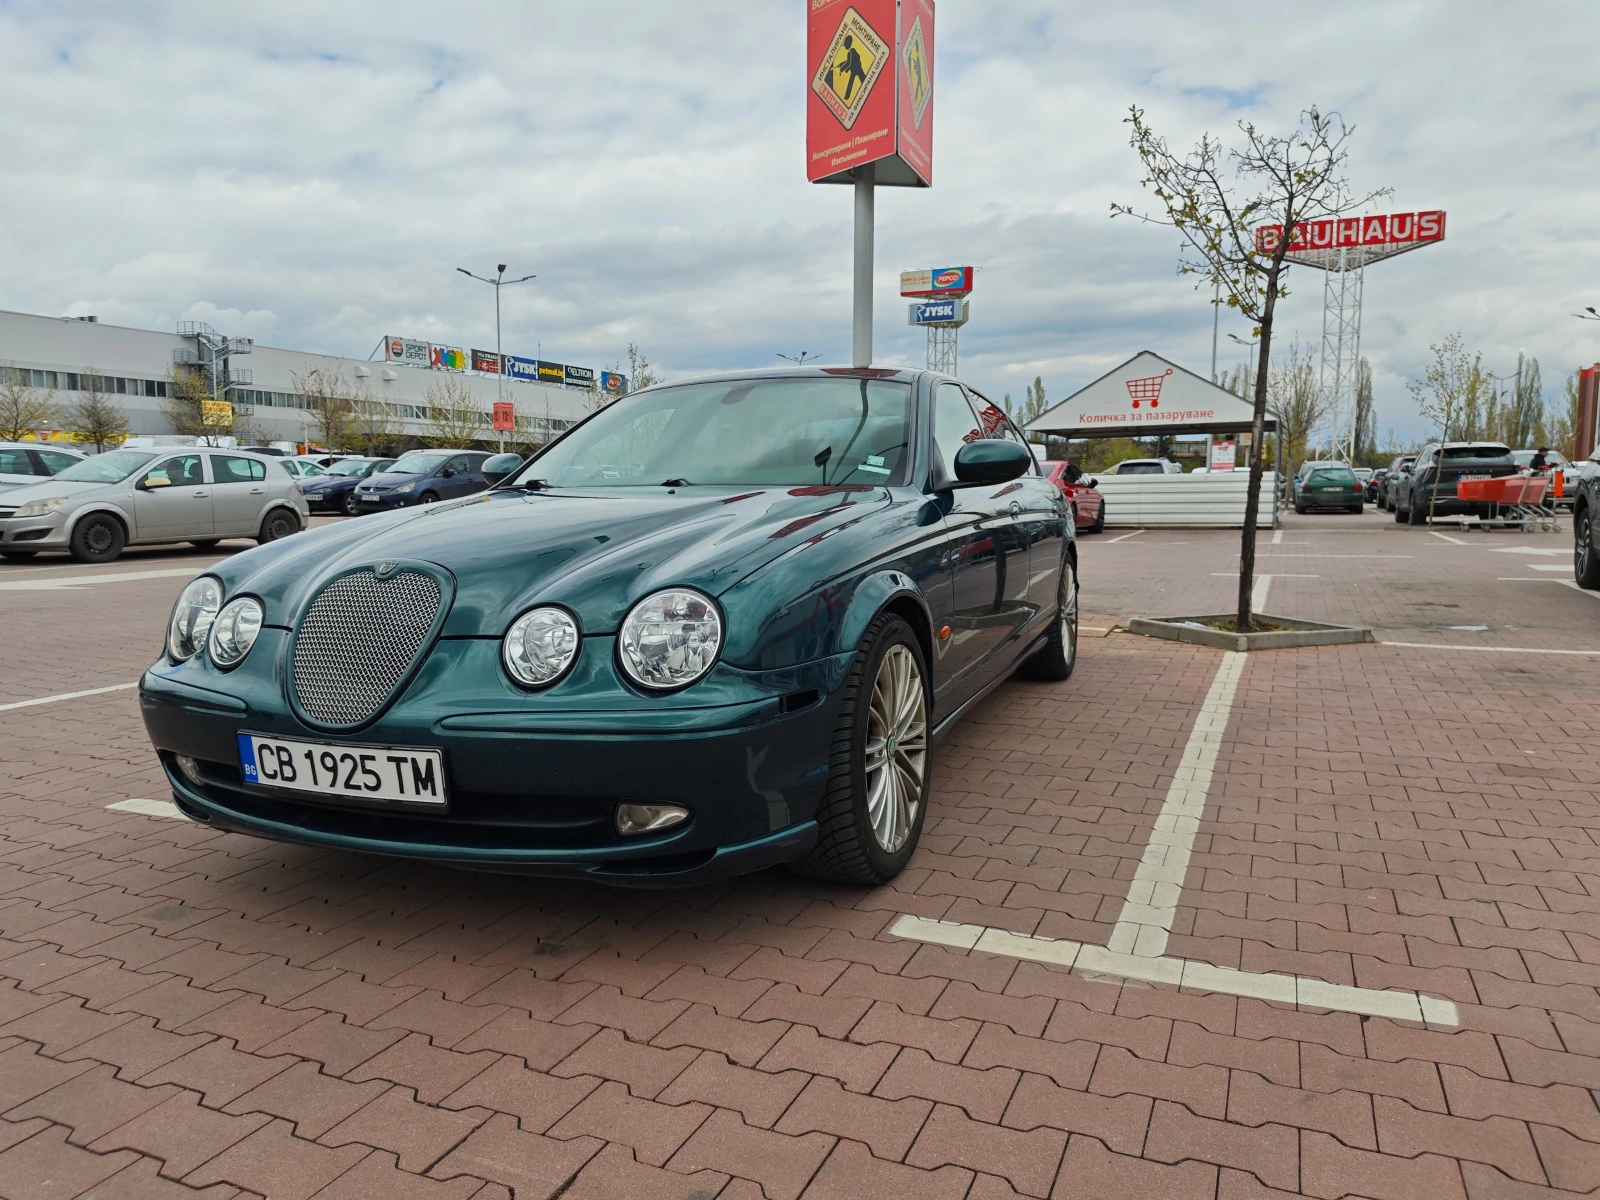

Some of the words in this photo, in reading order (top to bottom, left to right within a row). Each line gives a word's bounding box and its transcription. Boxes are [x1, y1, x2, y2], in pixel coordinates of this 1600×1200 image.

[851, 17, 882, 53] МОНТИРАНЕ
[818, 22, 848, 81] ИНСТАЛИРАНЕ
[853, 70, 876, 111] ФИКСИРАНА
[874, 51, 886, 71] ЦЕНА
[819, 82, 848, 122] BAUHAUS
[854, 128, 888, 146] Планиране
[831, 148, 868, 166] Изпълнение
[938, 273, 957, 282] PEPCO
[924, 305, 953, 317] JYSK
[405, 343, 427, 353] SPORT
[405, 351, 427, 361] DEPOT
[513, 361, 536, 375] JYSK
[1079, 413, 1126, 423] Количка
[1130, 413, 1142, 421] за
[1146, 409, 1214, 422] пазаруване
[244, 763, 257, 776] BG
[257, 743, 297, 782] CB
[304, 749, 382, 792] 1925
[387, 755, 438, 797] TM
